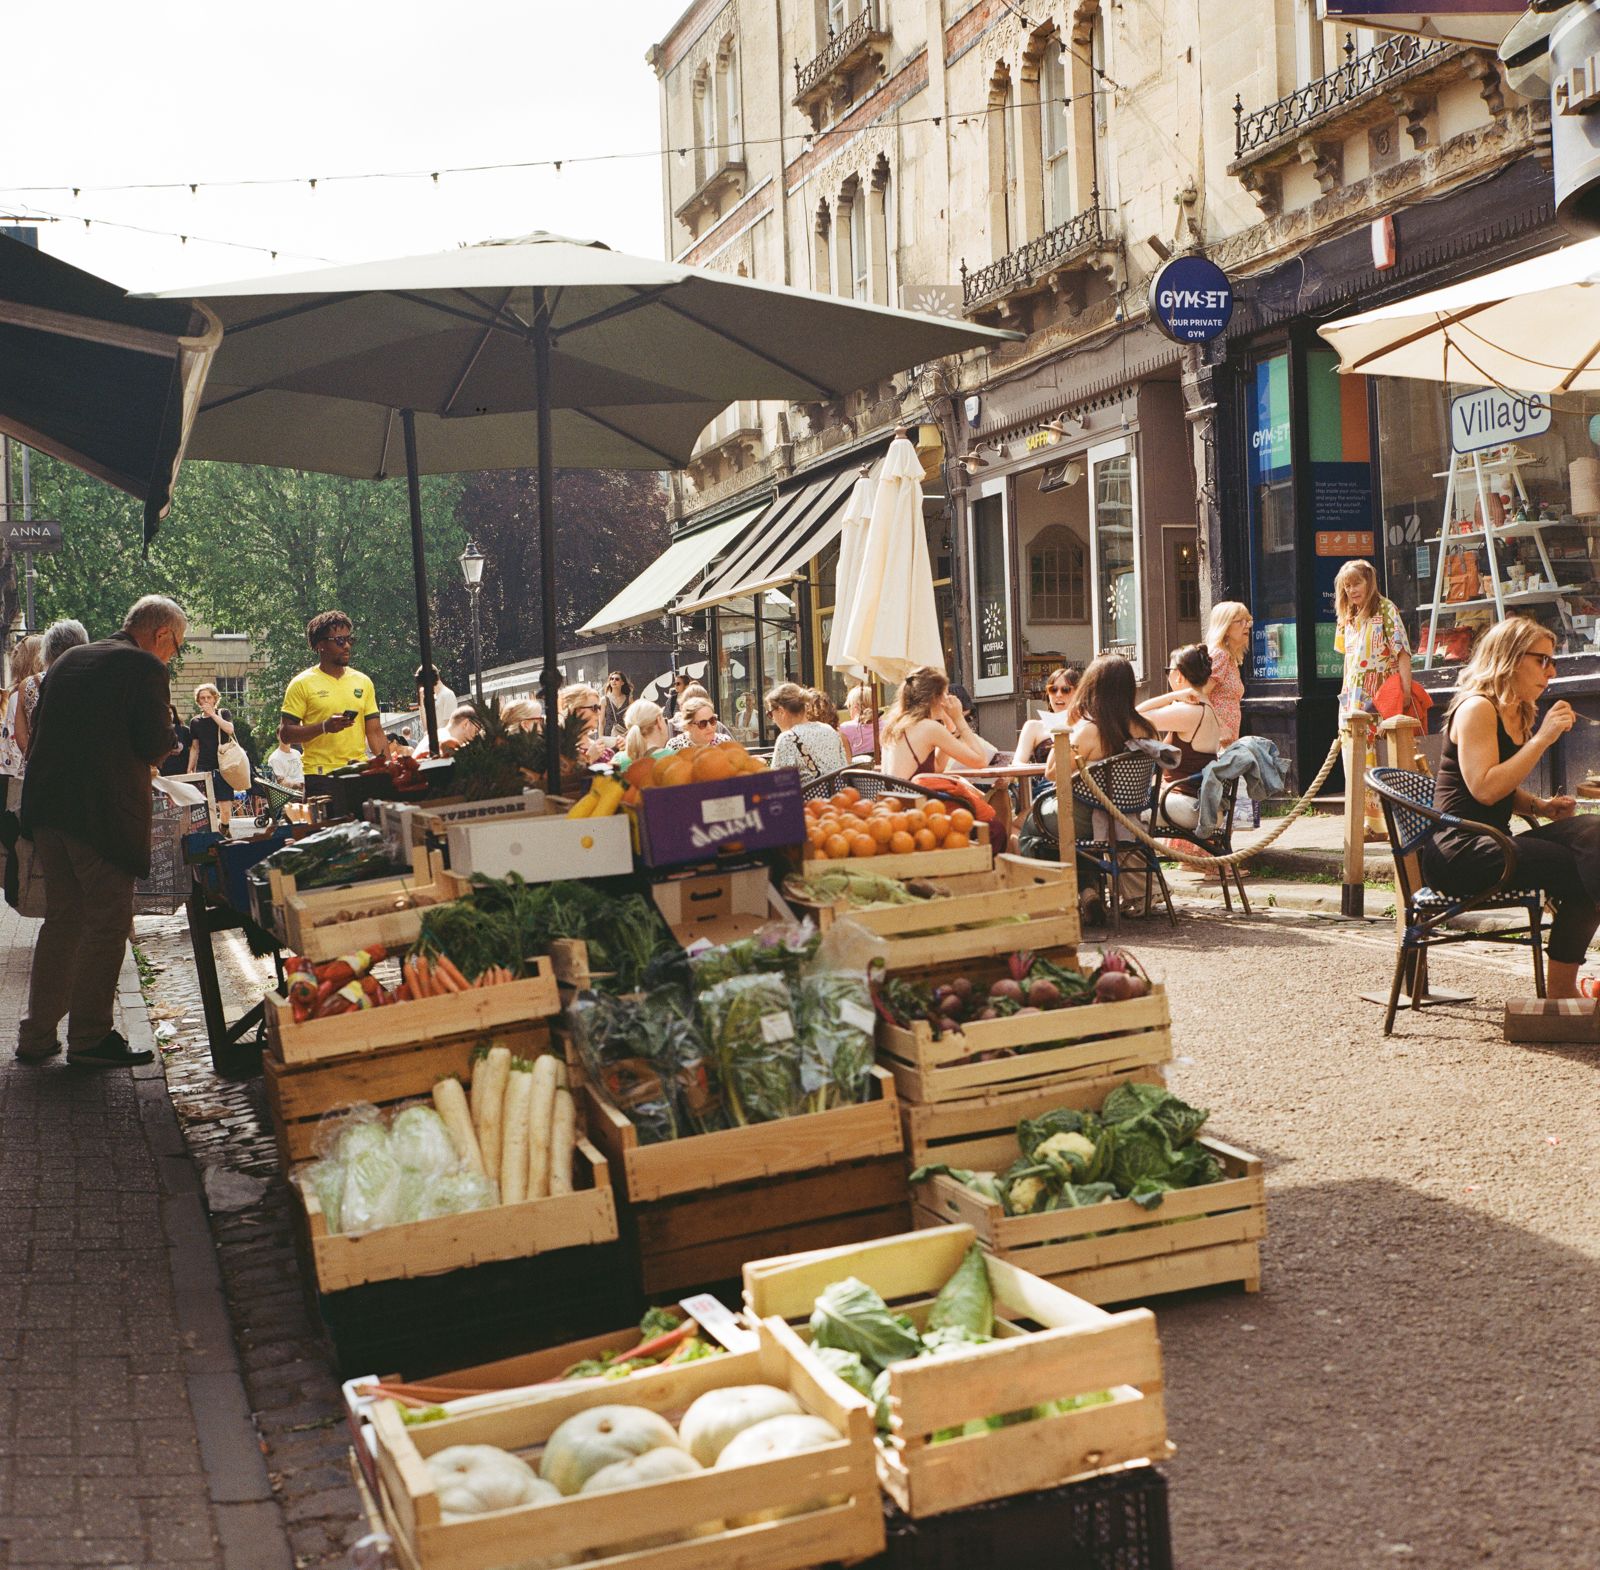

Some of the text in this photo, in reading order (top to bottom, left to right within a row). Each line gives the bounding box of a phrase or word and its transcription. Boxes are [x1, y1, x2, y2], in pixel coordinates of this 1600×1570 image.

[1552, 52, 1600, 116] CLI
[1160, 290, 1229, 309] GYMSET
[1167, 319, 1223, 327] YOUR PRIVATE
[1187, 330, 1205, 338] GYM
[1460, 394, 1543, 436] Village
[1026, 431, 1049, 451] SAFFR
[10, 527, 51, 537] ANNA
[690, 808, 765, 848] daisy
